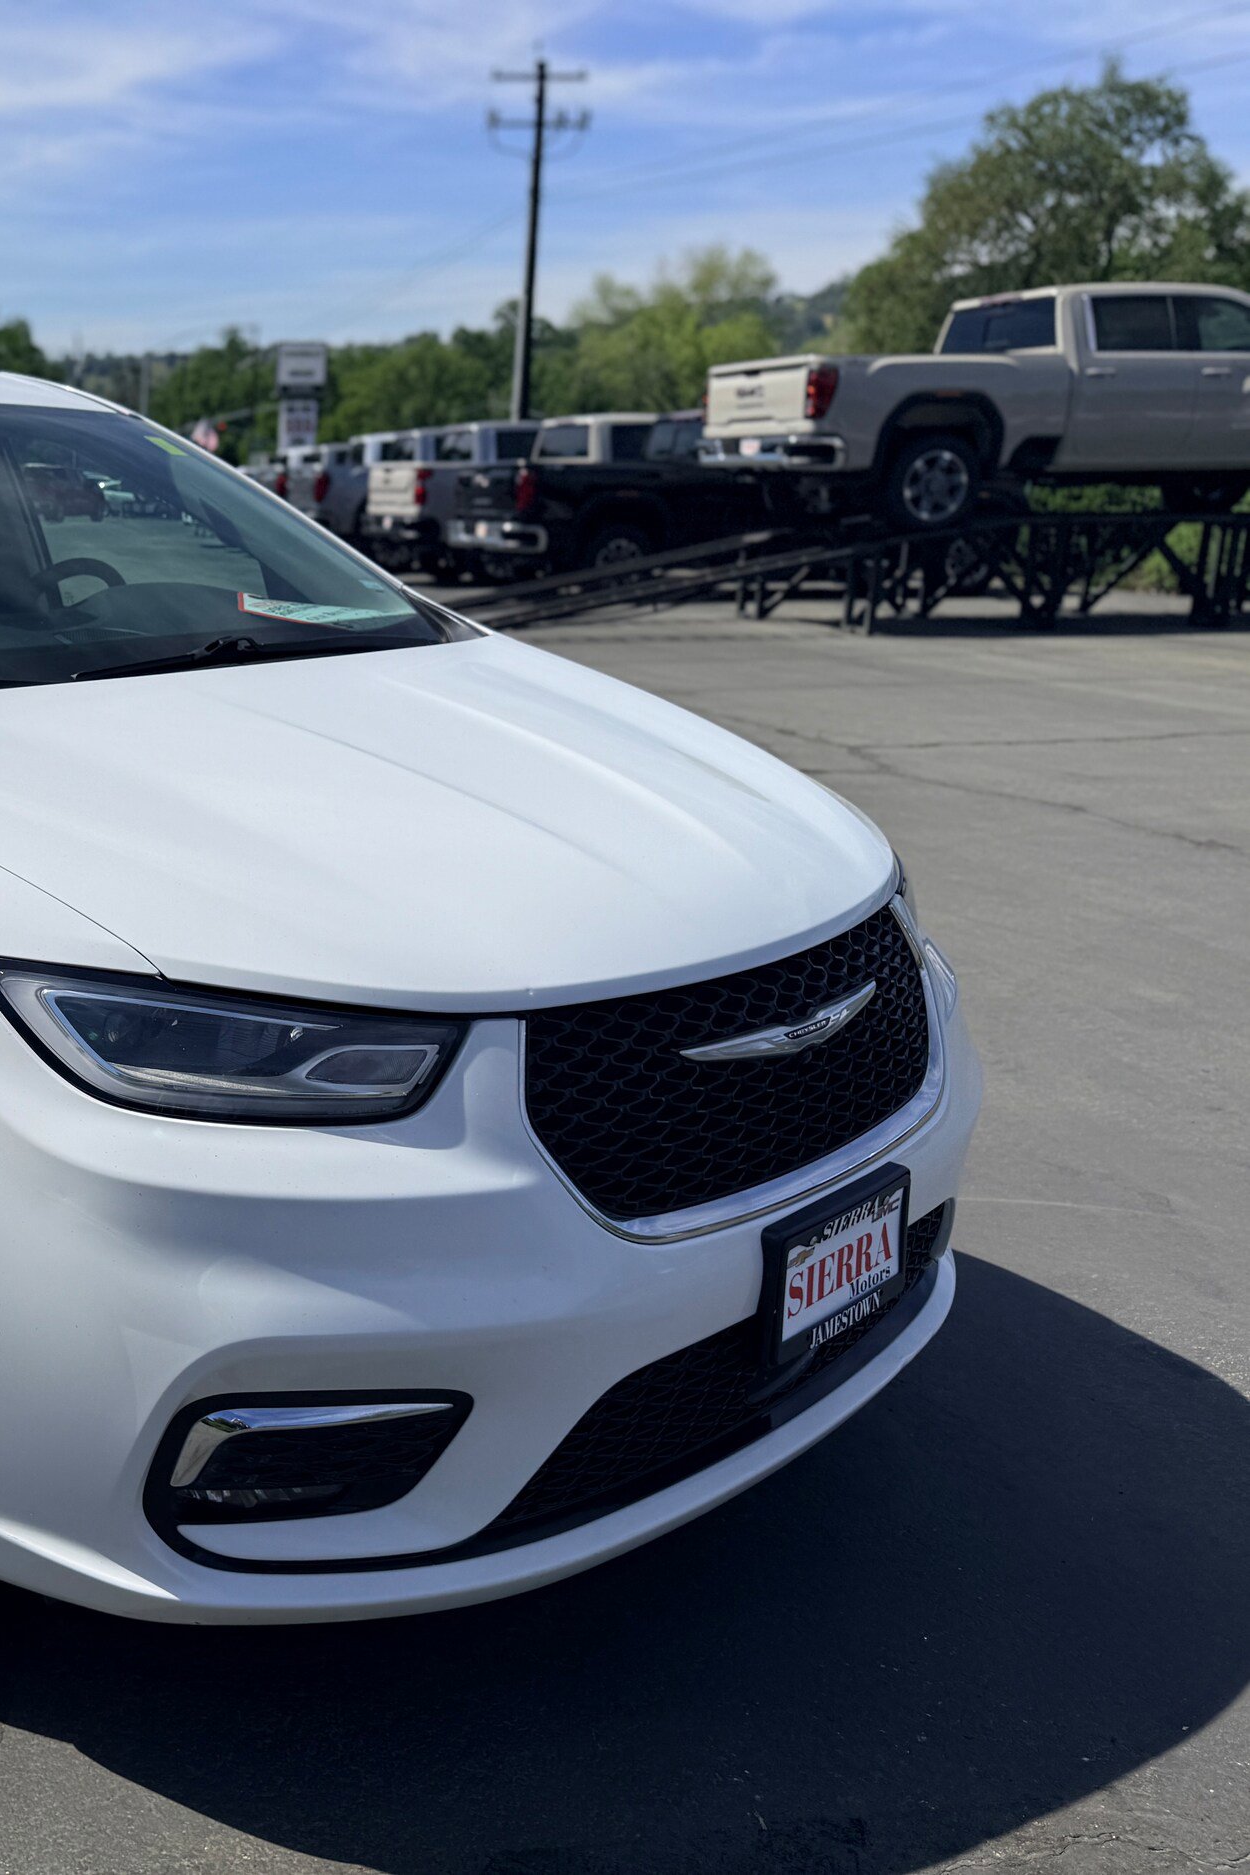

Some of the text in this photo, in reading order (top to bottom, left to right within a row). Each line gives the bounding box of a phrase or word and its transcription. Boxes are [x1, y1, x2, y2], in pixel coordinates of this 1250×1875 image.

[788, 1020, 827, 1039] CHRYSLER
[823, 1196, 880, 1240] SIERRA
[787, 1221, 893, 1320] SIERRA
[849, 1265, 891, 1300] Motors
[809, 1289, 882, 1350] JAMESTOWN
